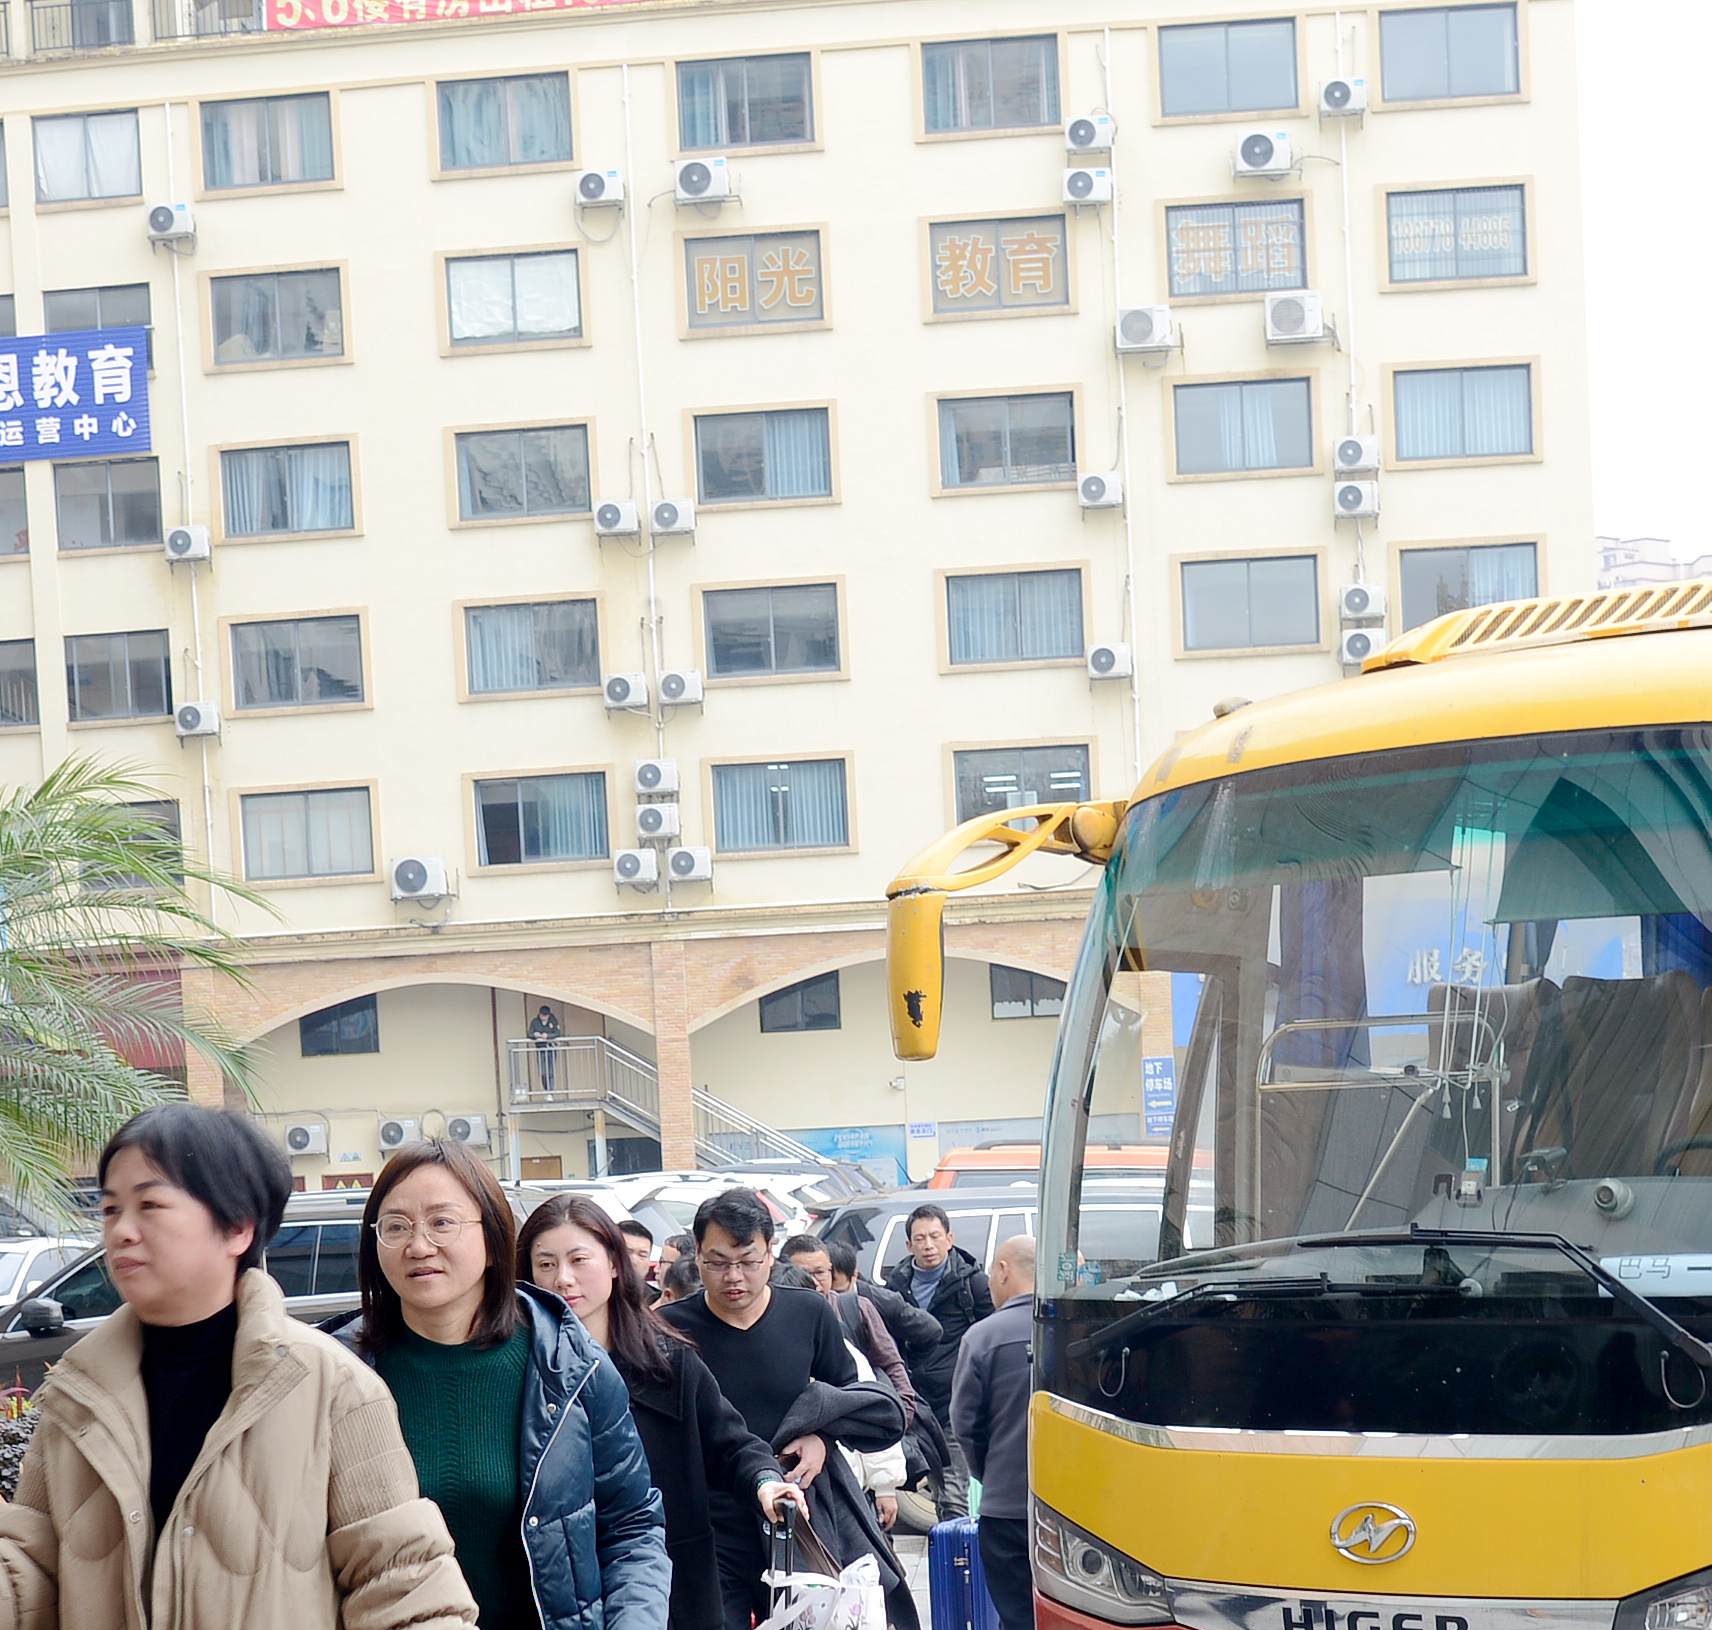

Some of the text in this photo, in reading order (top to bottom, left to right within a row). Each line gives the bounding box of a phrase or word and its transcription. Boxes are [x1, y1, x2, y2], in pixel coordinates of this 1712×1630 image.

[695, 247, 816, 315] 阳光
[936, 231, 1060, 298] 教育
[1145, 1061, 1164, 1075] 地下
[1145, 1077, 1173, 1092] 停车场
